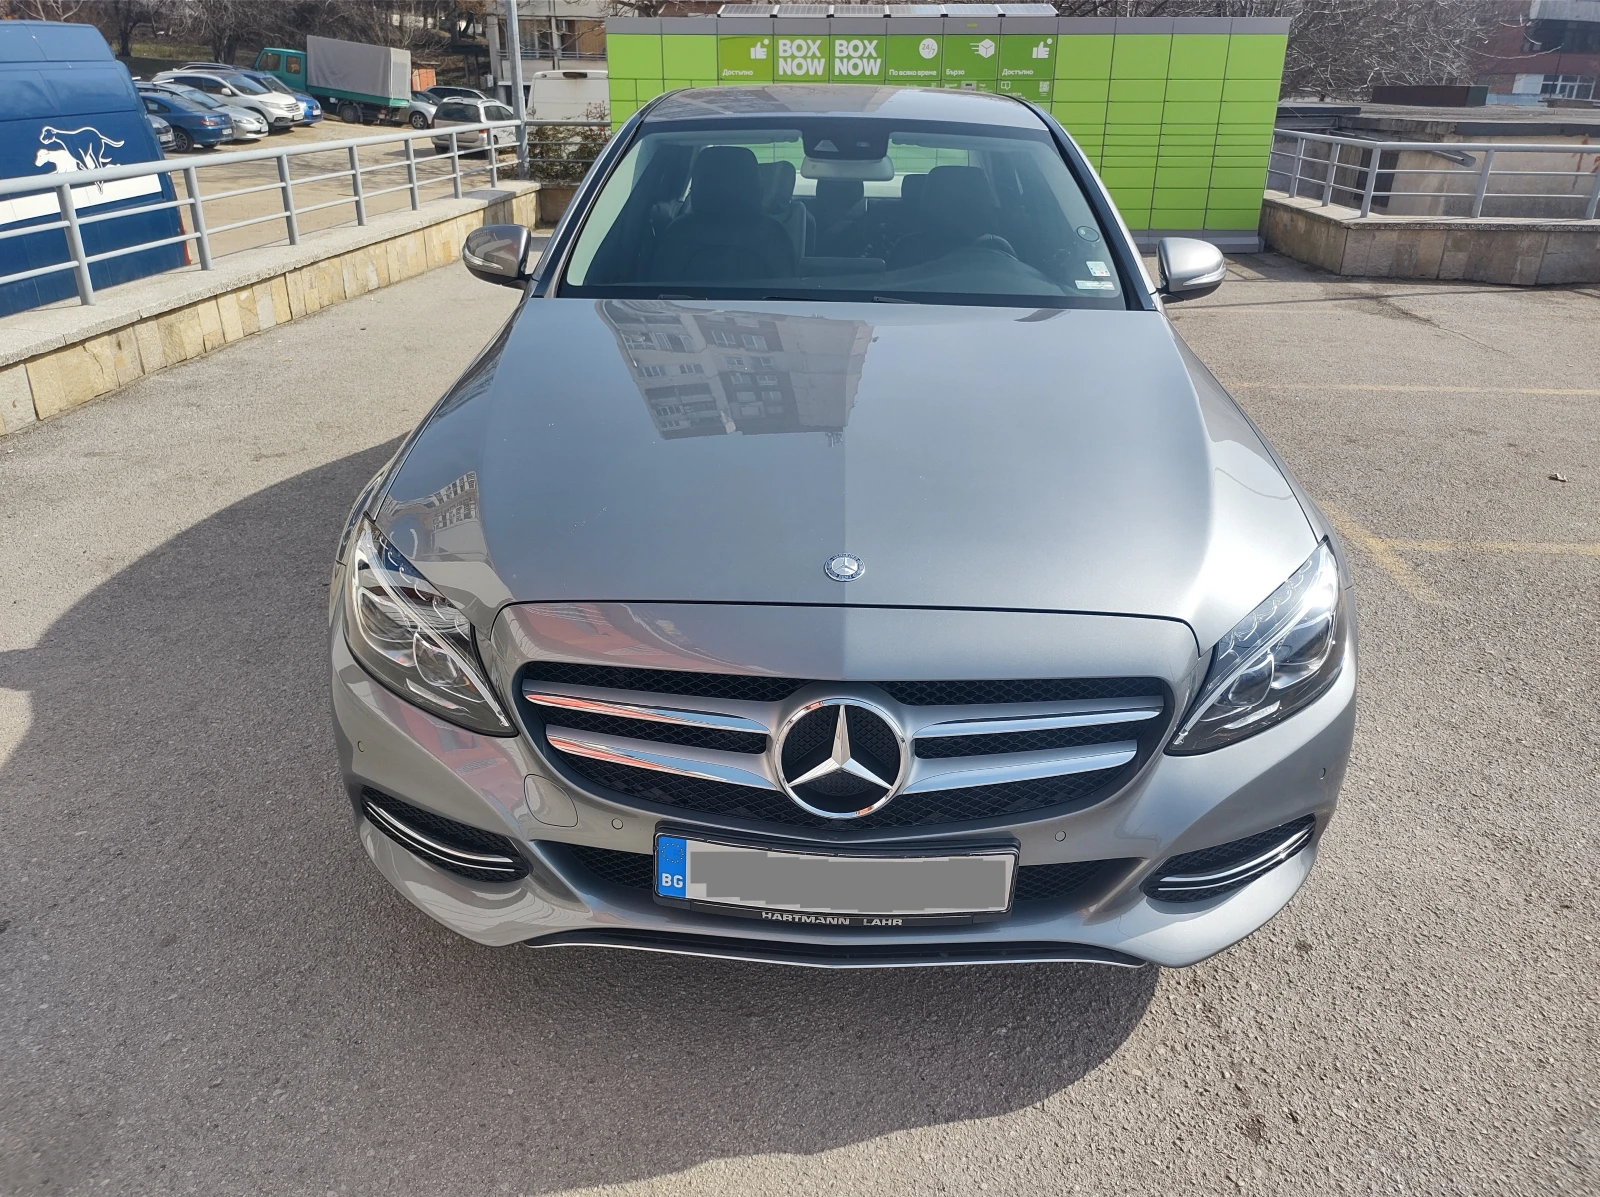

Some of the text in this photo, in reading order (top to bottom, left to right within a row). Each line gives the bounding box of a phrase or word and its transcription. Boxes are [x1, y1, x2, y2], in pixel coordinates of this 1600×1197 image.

[778, 39, 822, 57] BOX
[834, 39, 878, 57] BOX
[922, 43, 936, 55] 24/7
[722, 68, 753, 76] Достъпно
[778, 58, 825, 75] NOW
[834, 58, 881, 75] NOW
[917, 69, 937, 77] време
[1001, 68, 1033, 76] Достъпно
[661, 873, 684, 889] BG
[761, 911, 903, 926] HARTMANN LAHR
